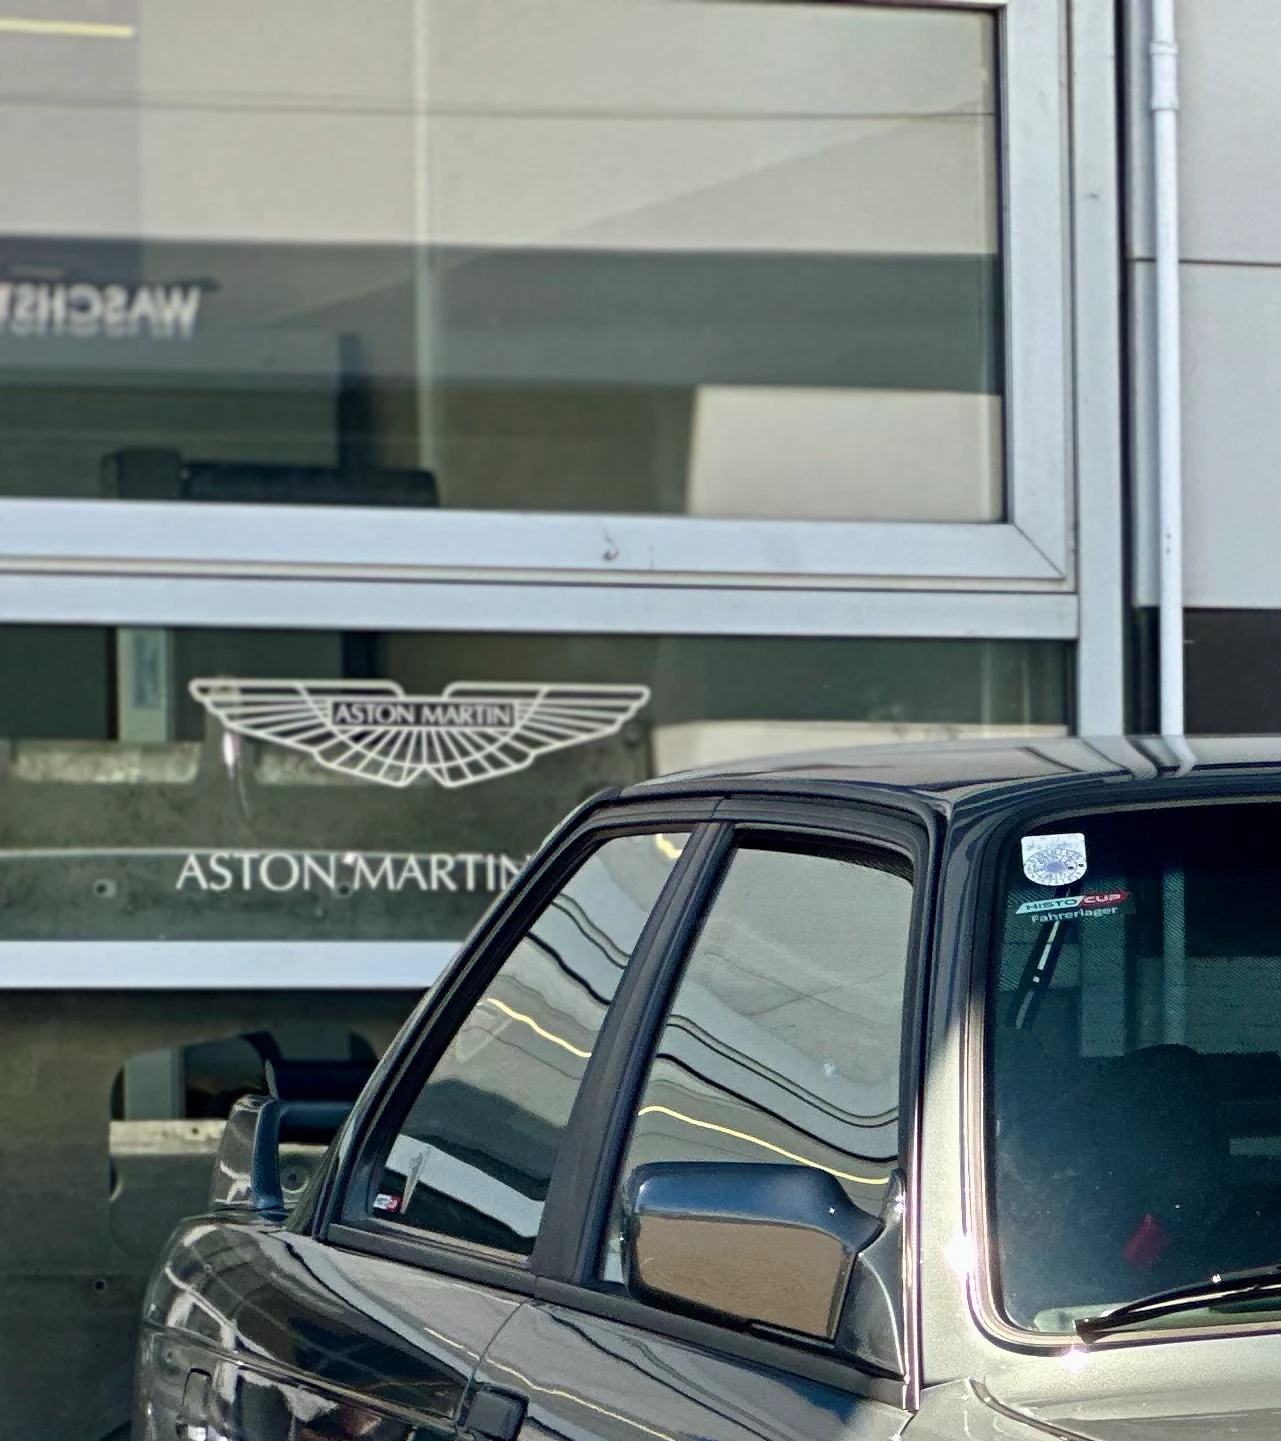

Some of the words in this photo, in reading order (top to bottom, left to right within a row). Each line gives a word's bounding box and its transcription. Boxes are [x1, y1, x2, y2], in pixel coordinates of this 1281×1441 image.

[334, 703, 414, 724] ASTON
[421, 703, 511, 726] MARTIN
[176, 853, 337, 891] ASTON
[353, 855, 531, 892] MARTIN
[1025, 899, 1078, 911] HISTO
[1083, 893, 1121, 904] CUP
